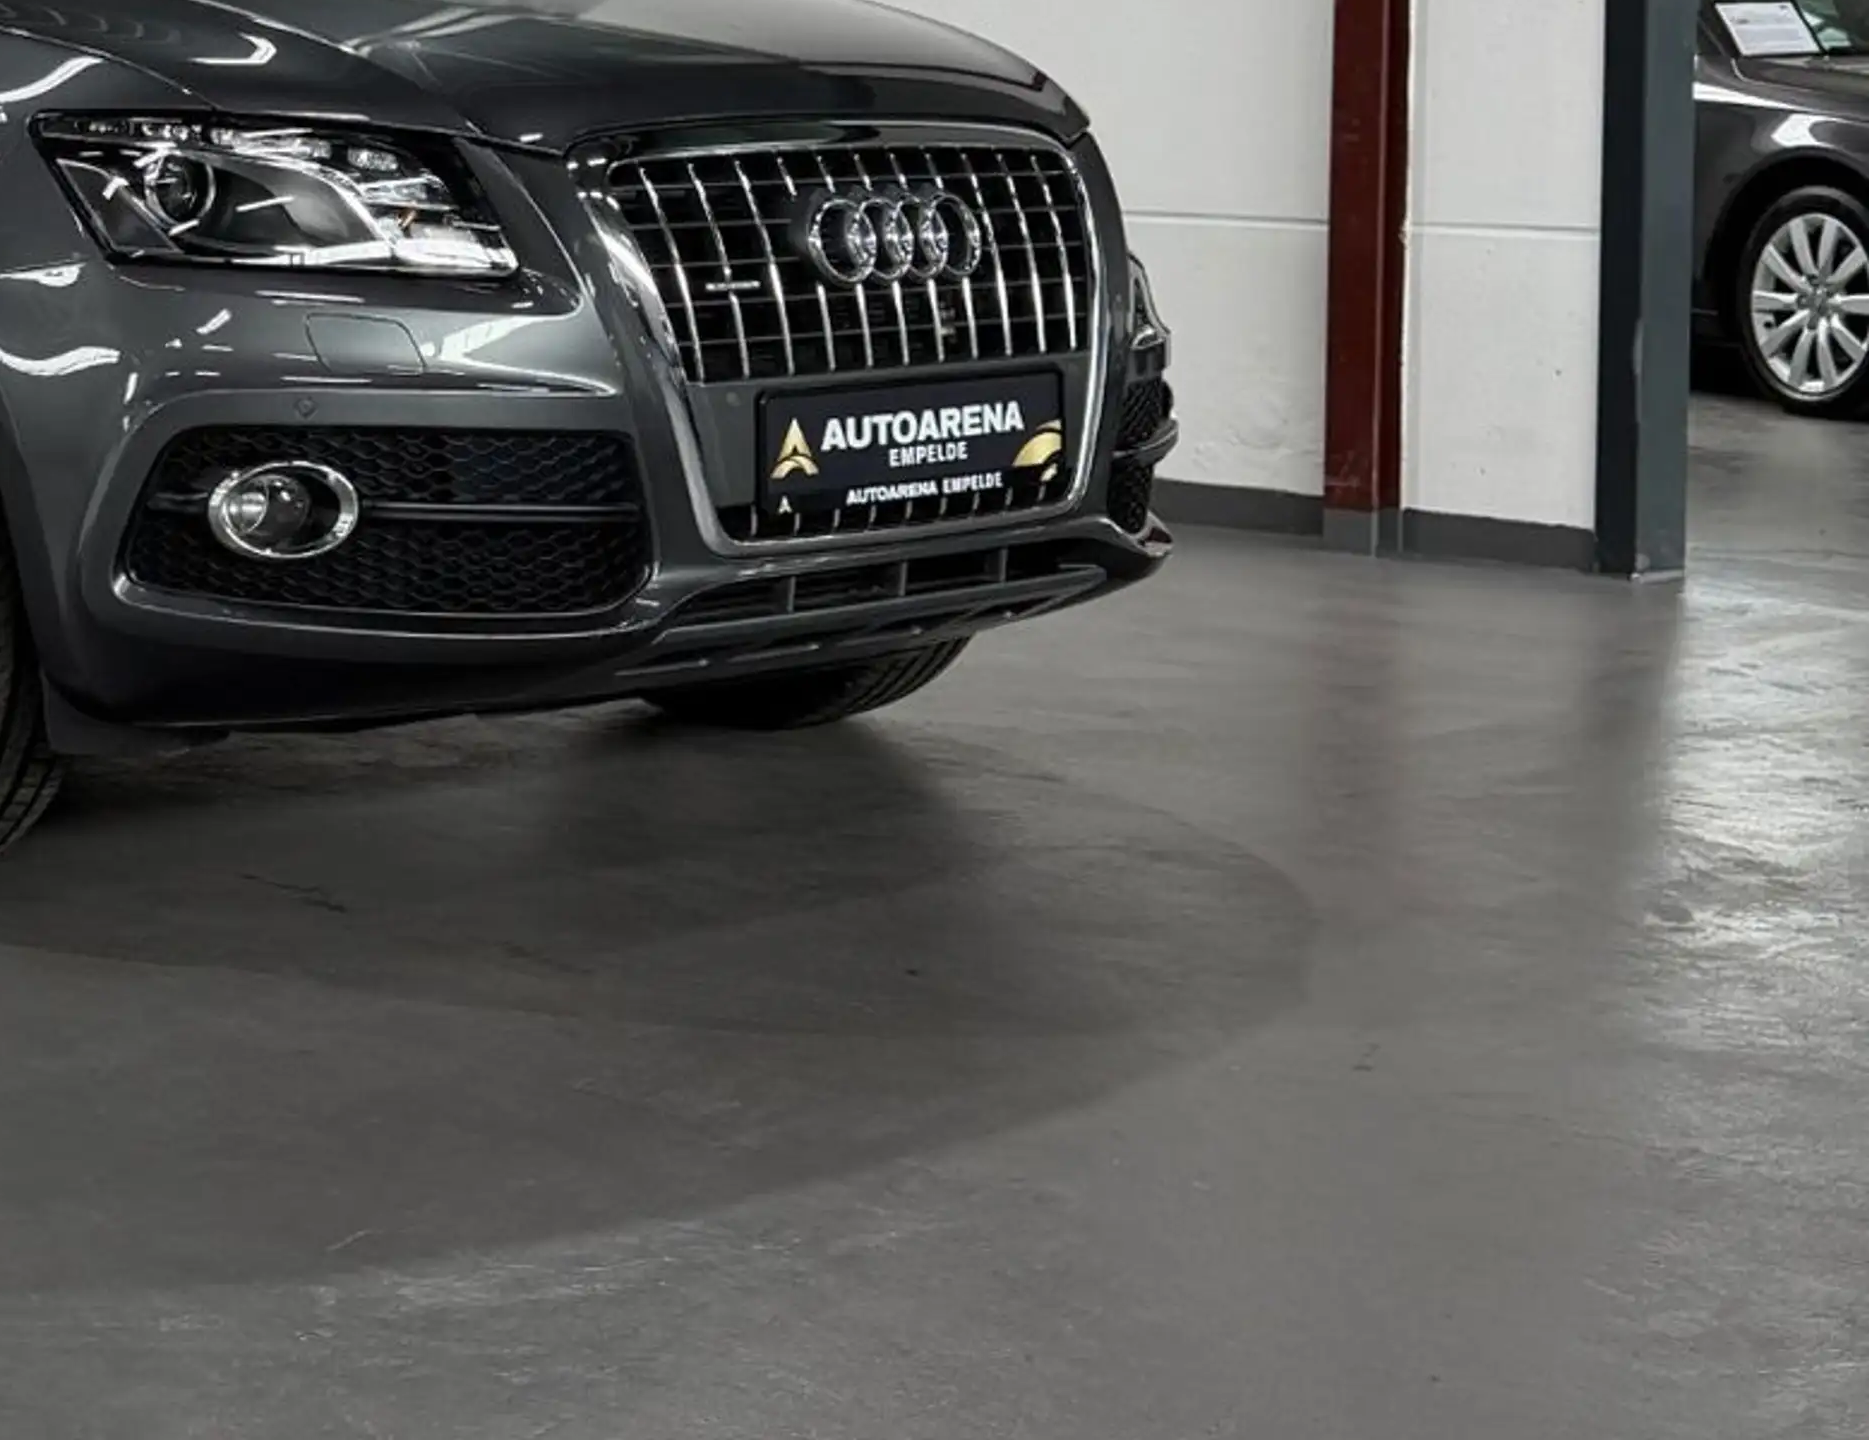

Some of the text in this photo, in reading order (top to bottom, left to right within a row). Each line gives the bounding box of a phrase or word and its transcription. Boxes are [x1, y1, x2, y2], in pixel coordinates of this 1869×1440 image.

[820, 400, 1025, 452] AUTOARENA
[888, 440, 969, 468] EMPELDE
[845, 471, 1004, 506] AUTOARENA EMPELDE
